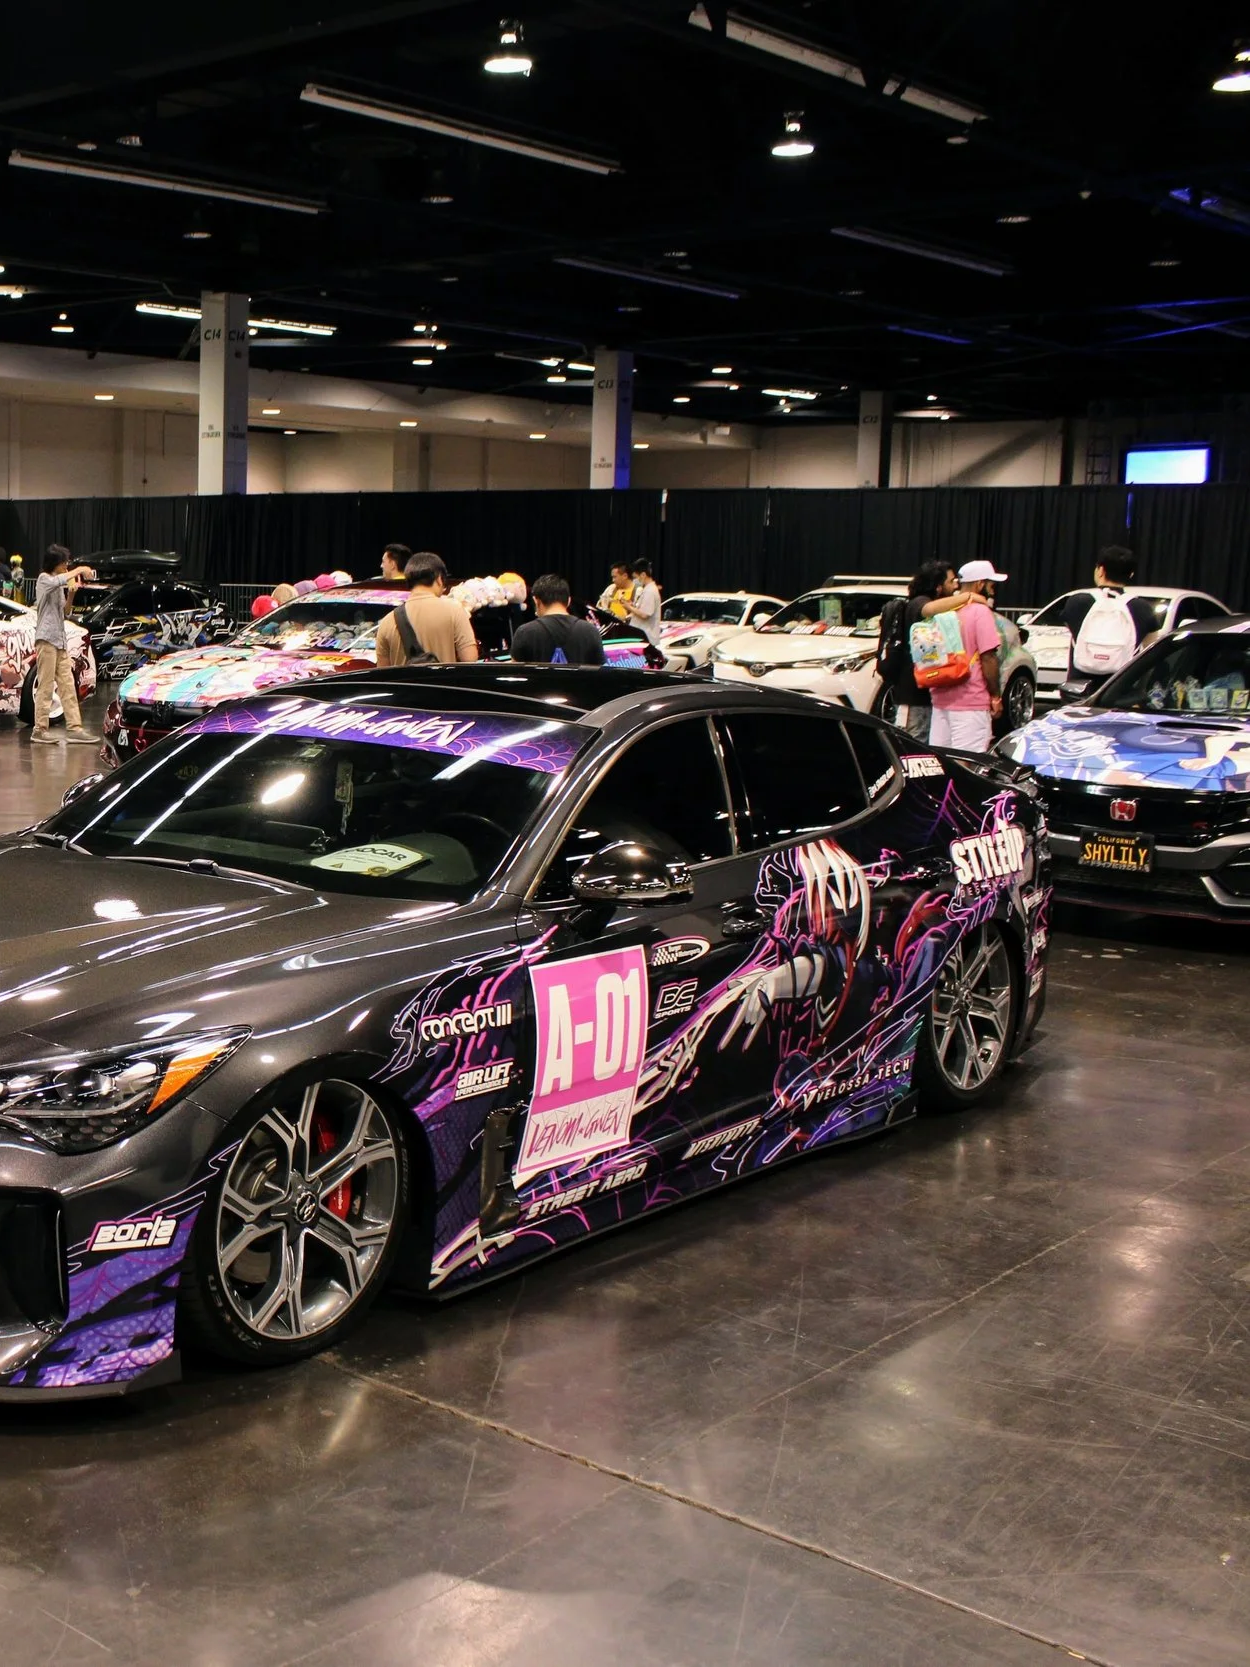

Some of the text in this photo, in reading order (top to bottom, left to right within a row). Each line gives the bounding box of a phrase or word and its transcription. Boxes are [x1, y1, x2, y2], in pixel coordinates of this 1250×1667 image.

[204, 328, 221, 341] C14
[1083, 842, 1148, 866] SHYLILY
[1097, 835, 1136, 845] CALIFORNIA
[656, 981, 699, 1013] DC
[654, 1005, 693, 1020] SPORTS
[539, 967, 640, 1097] A-01
[484, 1061, 514, 1082] LIFT
[816, 1073, 870, 1103] VELOSSA
[877, 1058, 911, 1080] TECH
[527, 1104, 625, 1159] VENOM GWEN
[525, 1162, 648, 1221] STREET AERO
